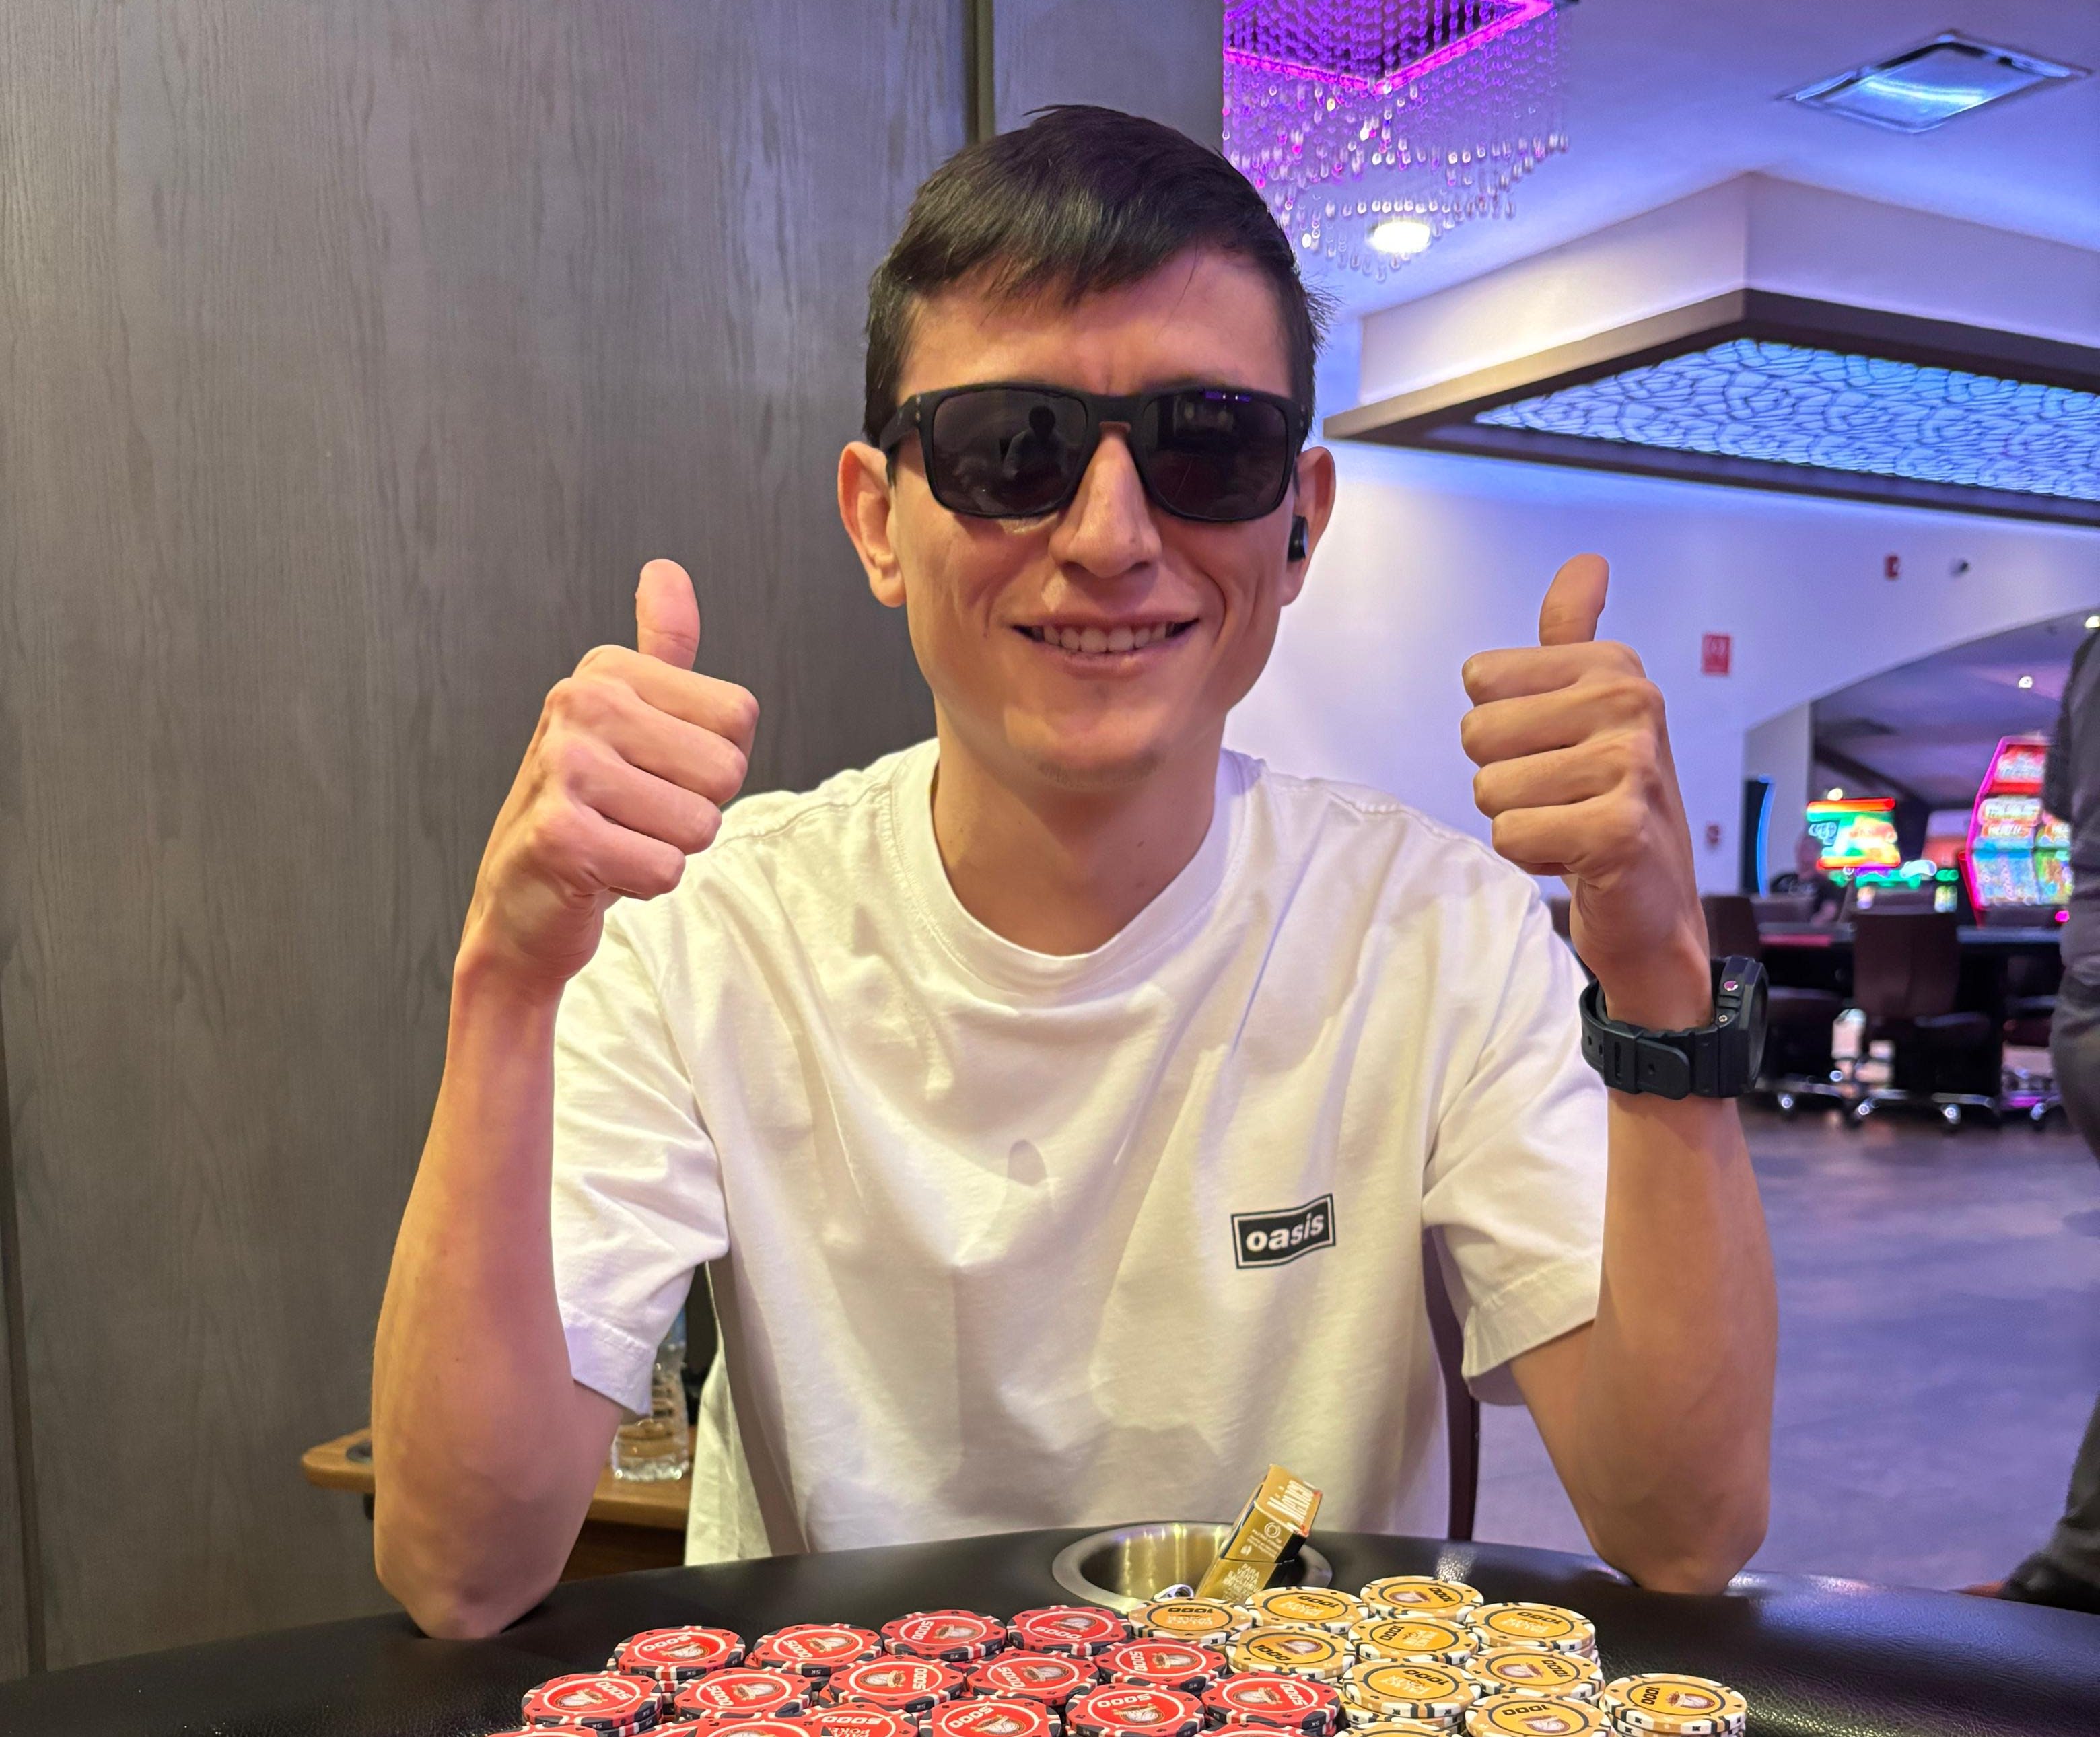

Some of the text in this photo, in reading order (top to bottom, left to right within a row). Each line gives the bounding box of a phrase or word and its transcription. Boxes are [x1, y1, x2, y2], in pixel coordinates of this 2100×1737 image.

[1246, 1212, 1325, 1252] oasis
[1242, 1563, 1260, 1577] PARA
[1298, 1596, 1339, 1608] 1000
[1428, 1587, 1455, 1602] 1000
[1517, 1611, 1563, 1624] 1000
[911, 1620, 934, 1641] 5000
[1032, 1626, 1082, 1639] 5000
[1380, 1625, 1405, 1641] 1000
[643, 1635, 692, 1652] 5000
[783, 1639, 814, 1658] 5000
[1129, 1650, 1148, 1672] 5000
[1253, 1645, 1292, 1661] 1000
[996, 1666, 1026, 1687] 5000
[1403, 1669, 1449, 1685] 1000
[1542, 1660, 1571, 1677] 1000
[913, 1668, 928, 1691] 5000
[595, 1681, 633, 1700] 5000
[707, 1685, 734, 1706] 5000
[1279, 1684, 1310, 1706] 5000
[1640, 1686, 1660, 1705] 1000
[1096, 1693, 1152, 1708] 5000
[948, 1705, 994, 1728] 5000
[1502, 1704, 1551, 1715] 1000
[821, 1716, 884, 1724] 5000
